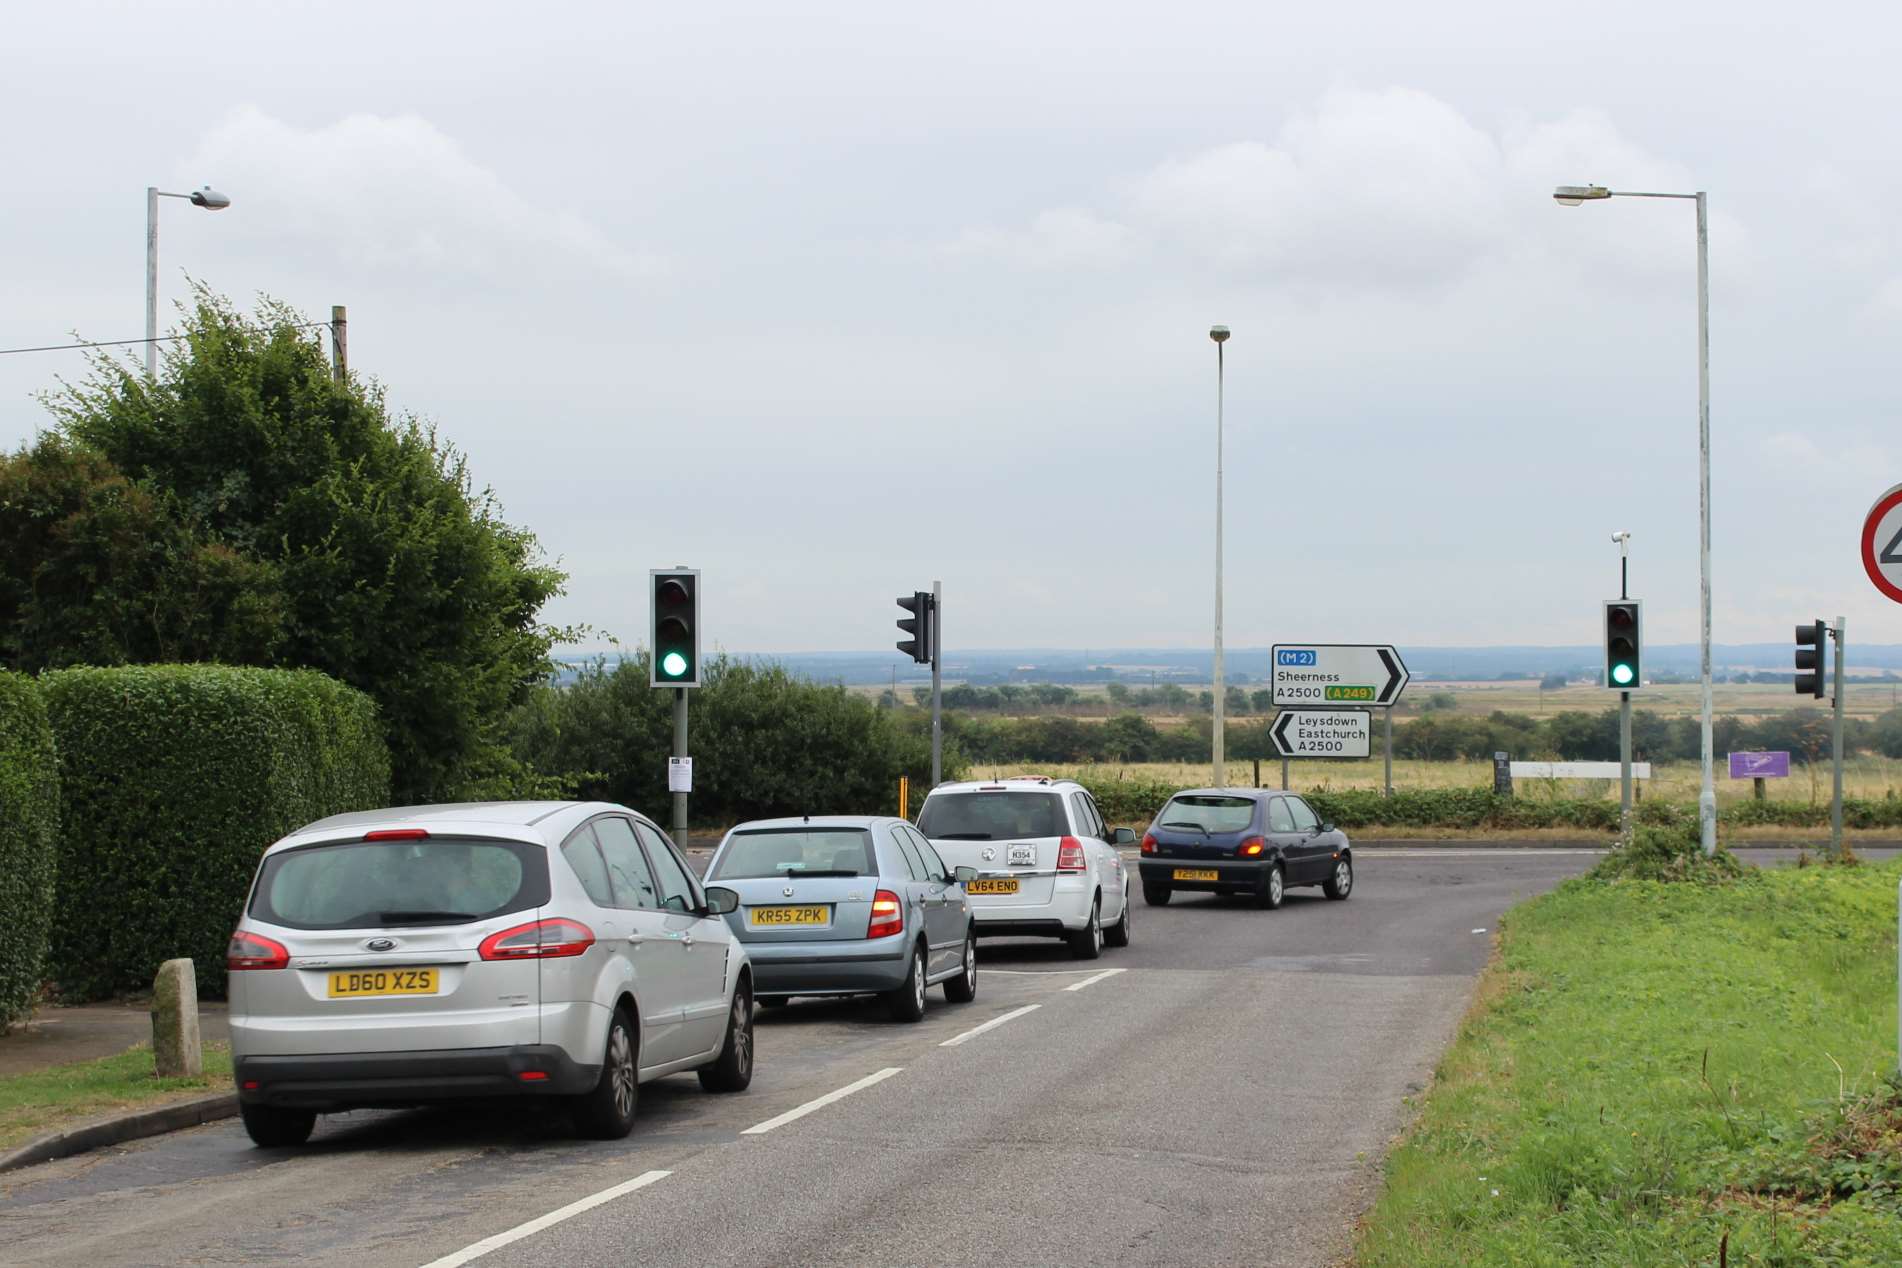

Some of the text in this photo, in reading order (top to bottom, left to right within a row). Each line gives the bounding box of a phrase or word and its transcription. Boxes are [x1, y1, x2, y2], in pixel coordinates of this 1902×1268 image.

[1278, 672, 1340, 682] Sheerness
[1277, 688, 1321, 698] A2500
[1299, 716, 1358, 727] Leysdown
[1299, 728, 1366, 739] Eastchurch
[1298, 741, 1343, 751] A2500
[967, 881, 1018, 891] LV64 ENO
[757, 909, 821, 923] KR55 ZPK
[335, 971, 431, 992] LD60 XZS
